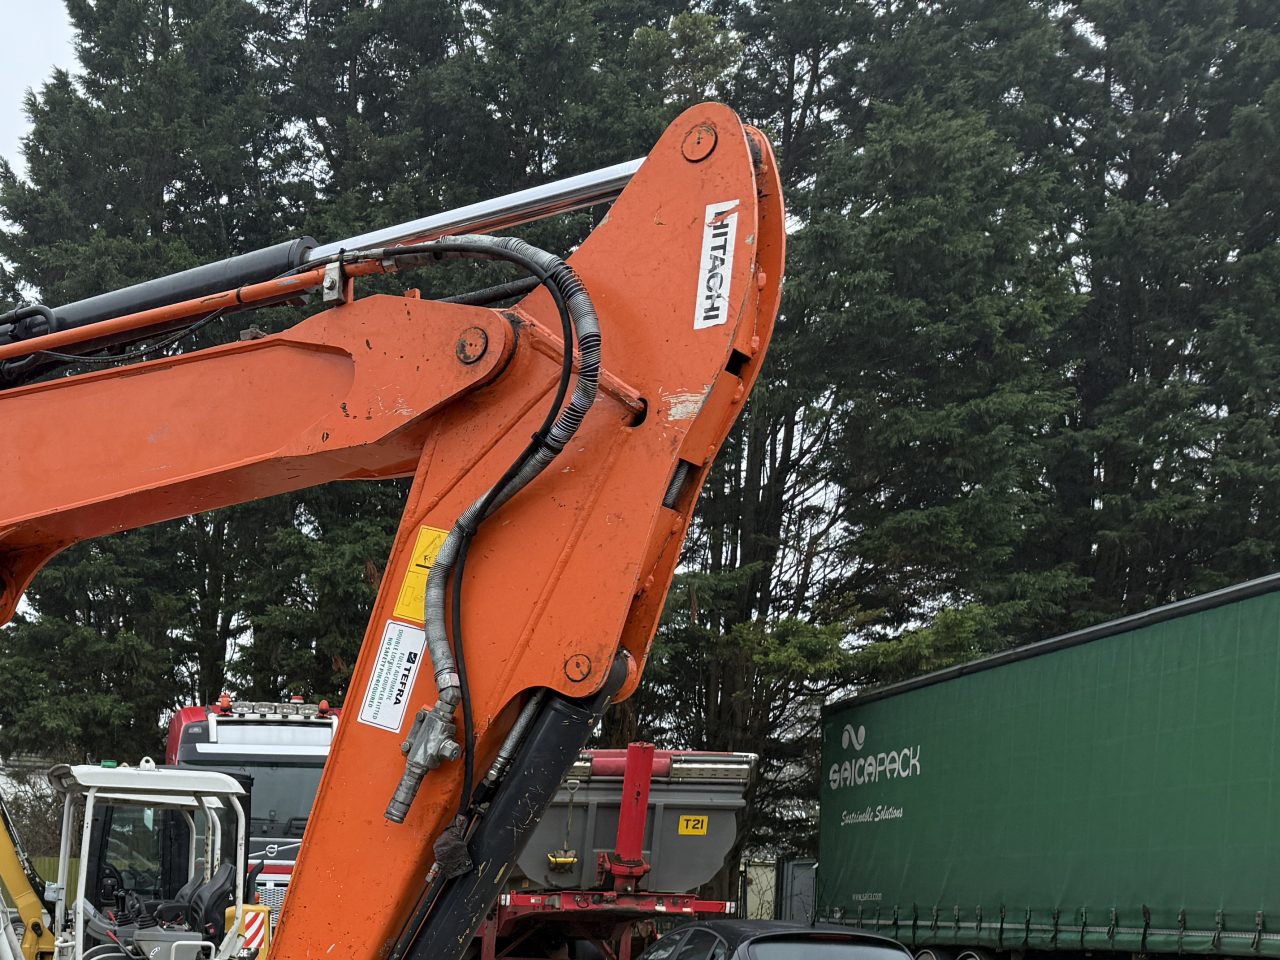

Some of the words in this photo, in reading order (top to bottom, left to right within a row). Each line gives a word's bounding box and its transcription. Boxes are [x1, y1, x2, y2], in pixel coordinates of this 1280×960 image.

[703, 211, 729, 321] HITACHI
[386, 637, 393, 646] NO
[393, 629, 403, 651] DOUBLE
[380, 647, 391, 668] SAFETY
[396, 652, 405, 669] FULLY
[368, 679, 380, 708] REQUIRED
[378, 676, 390, 700] COUPLER
[386, 670, 400, 700] AUTOMATIC
[394, 666, 411, 705] TEFRA
[372, 701, 382, 720] FITTED
[829, 745, 920, 790] SAICAPACK
[684, 819, 704, 830] T21
[840, 806, 874, 826] Sustainable
[874, 805, 903, 821] Solutions
